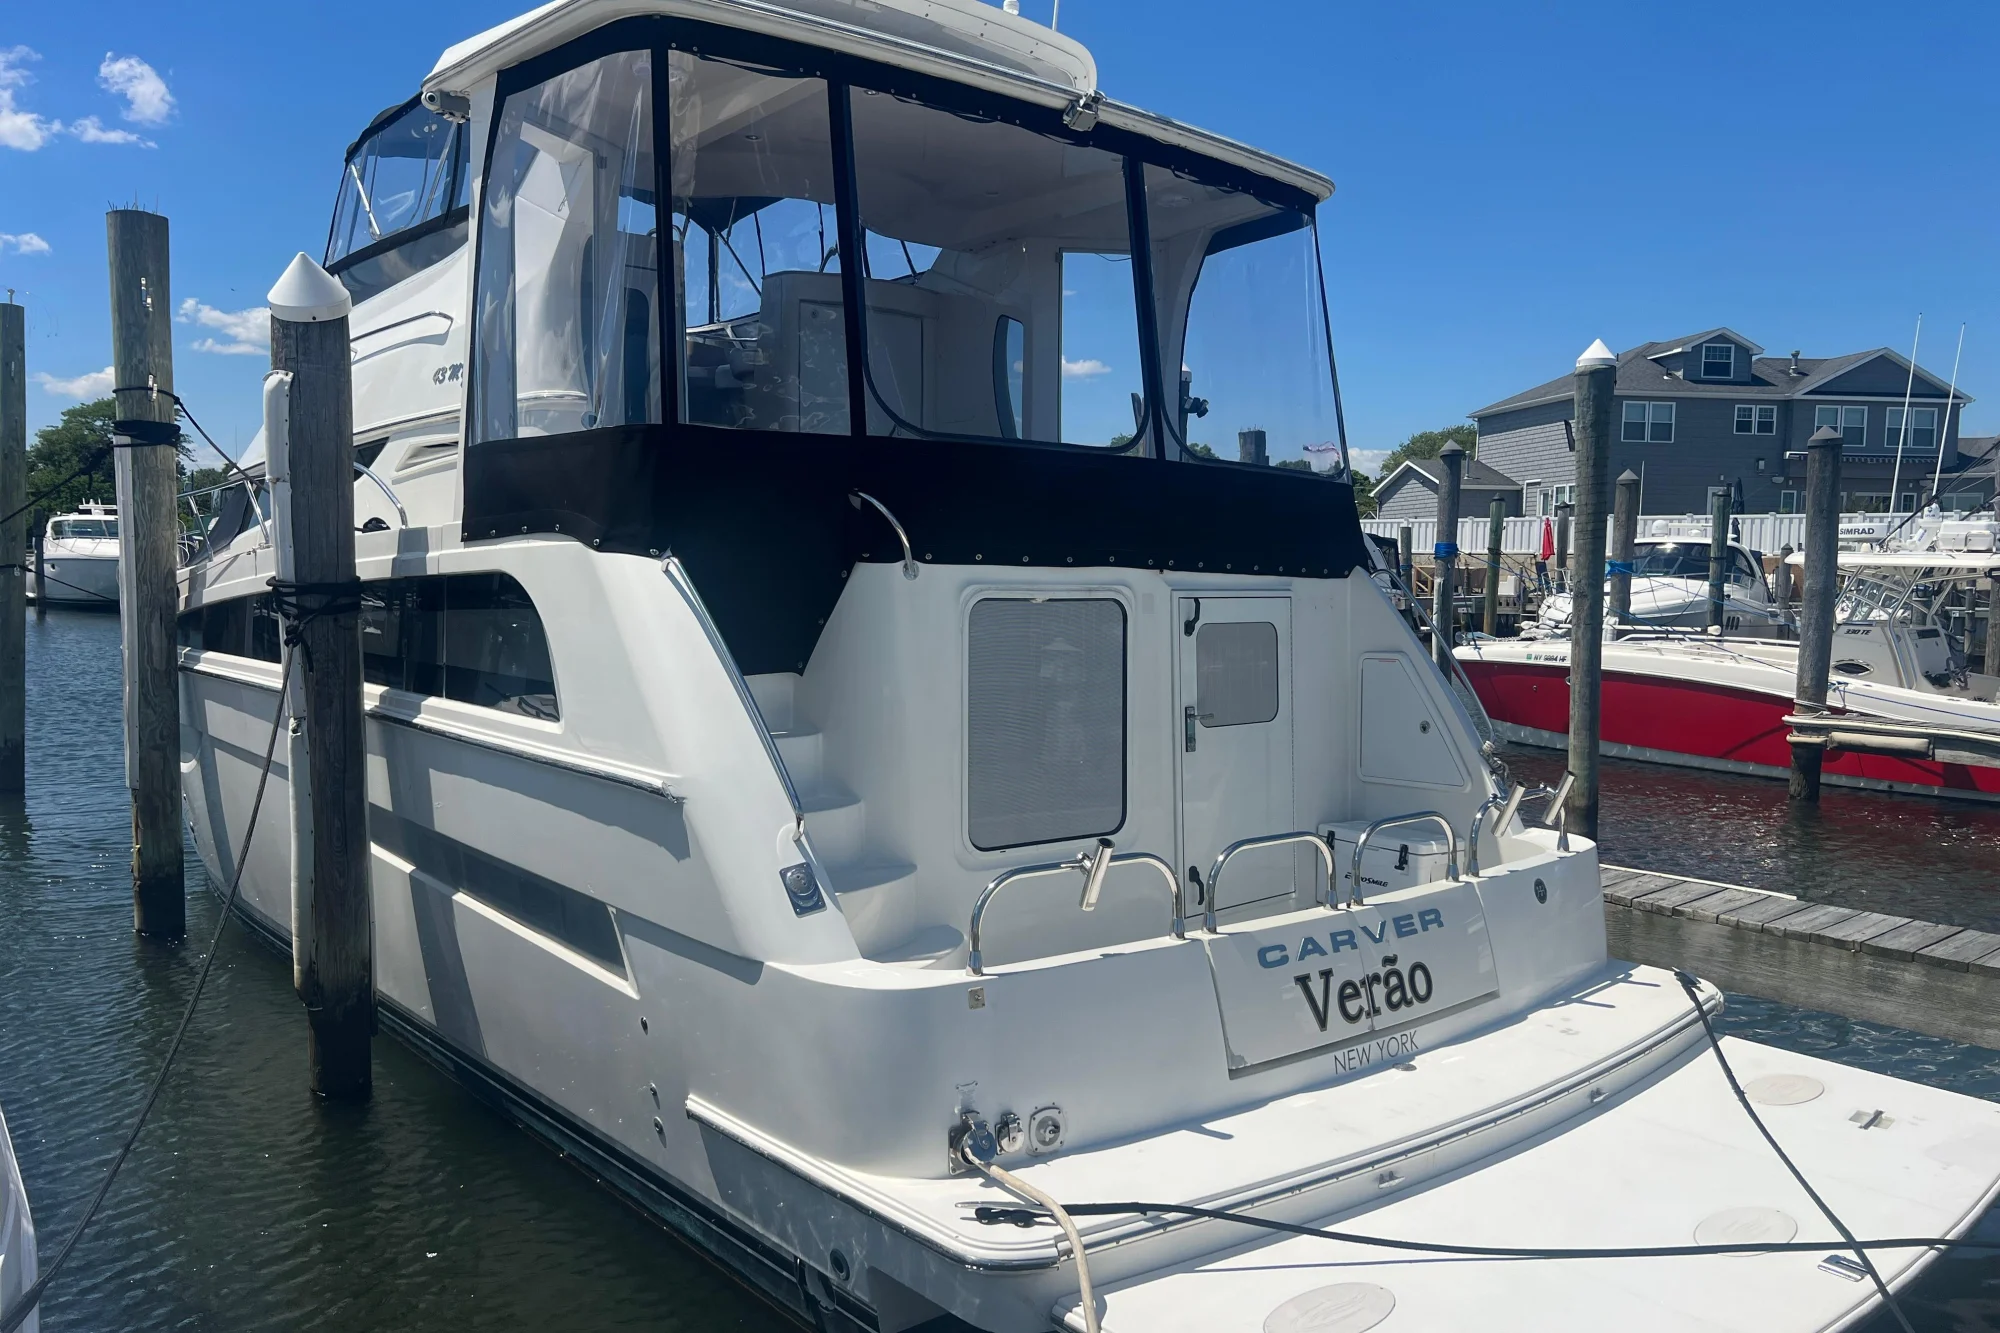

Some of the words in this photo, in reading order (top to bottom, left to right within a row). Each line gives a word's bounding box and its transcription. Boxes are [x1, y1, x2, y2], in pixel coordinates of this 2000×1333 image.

[1839, 527, 1875, 535] SIMRAD
[1256, 907, 1445, 969] CARVER
[1293, 953, 1434, 1033] Verão
[1333, 1044, 1372, 1075] NEW
[1376, 1030, 1420, 1061] YORK
